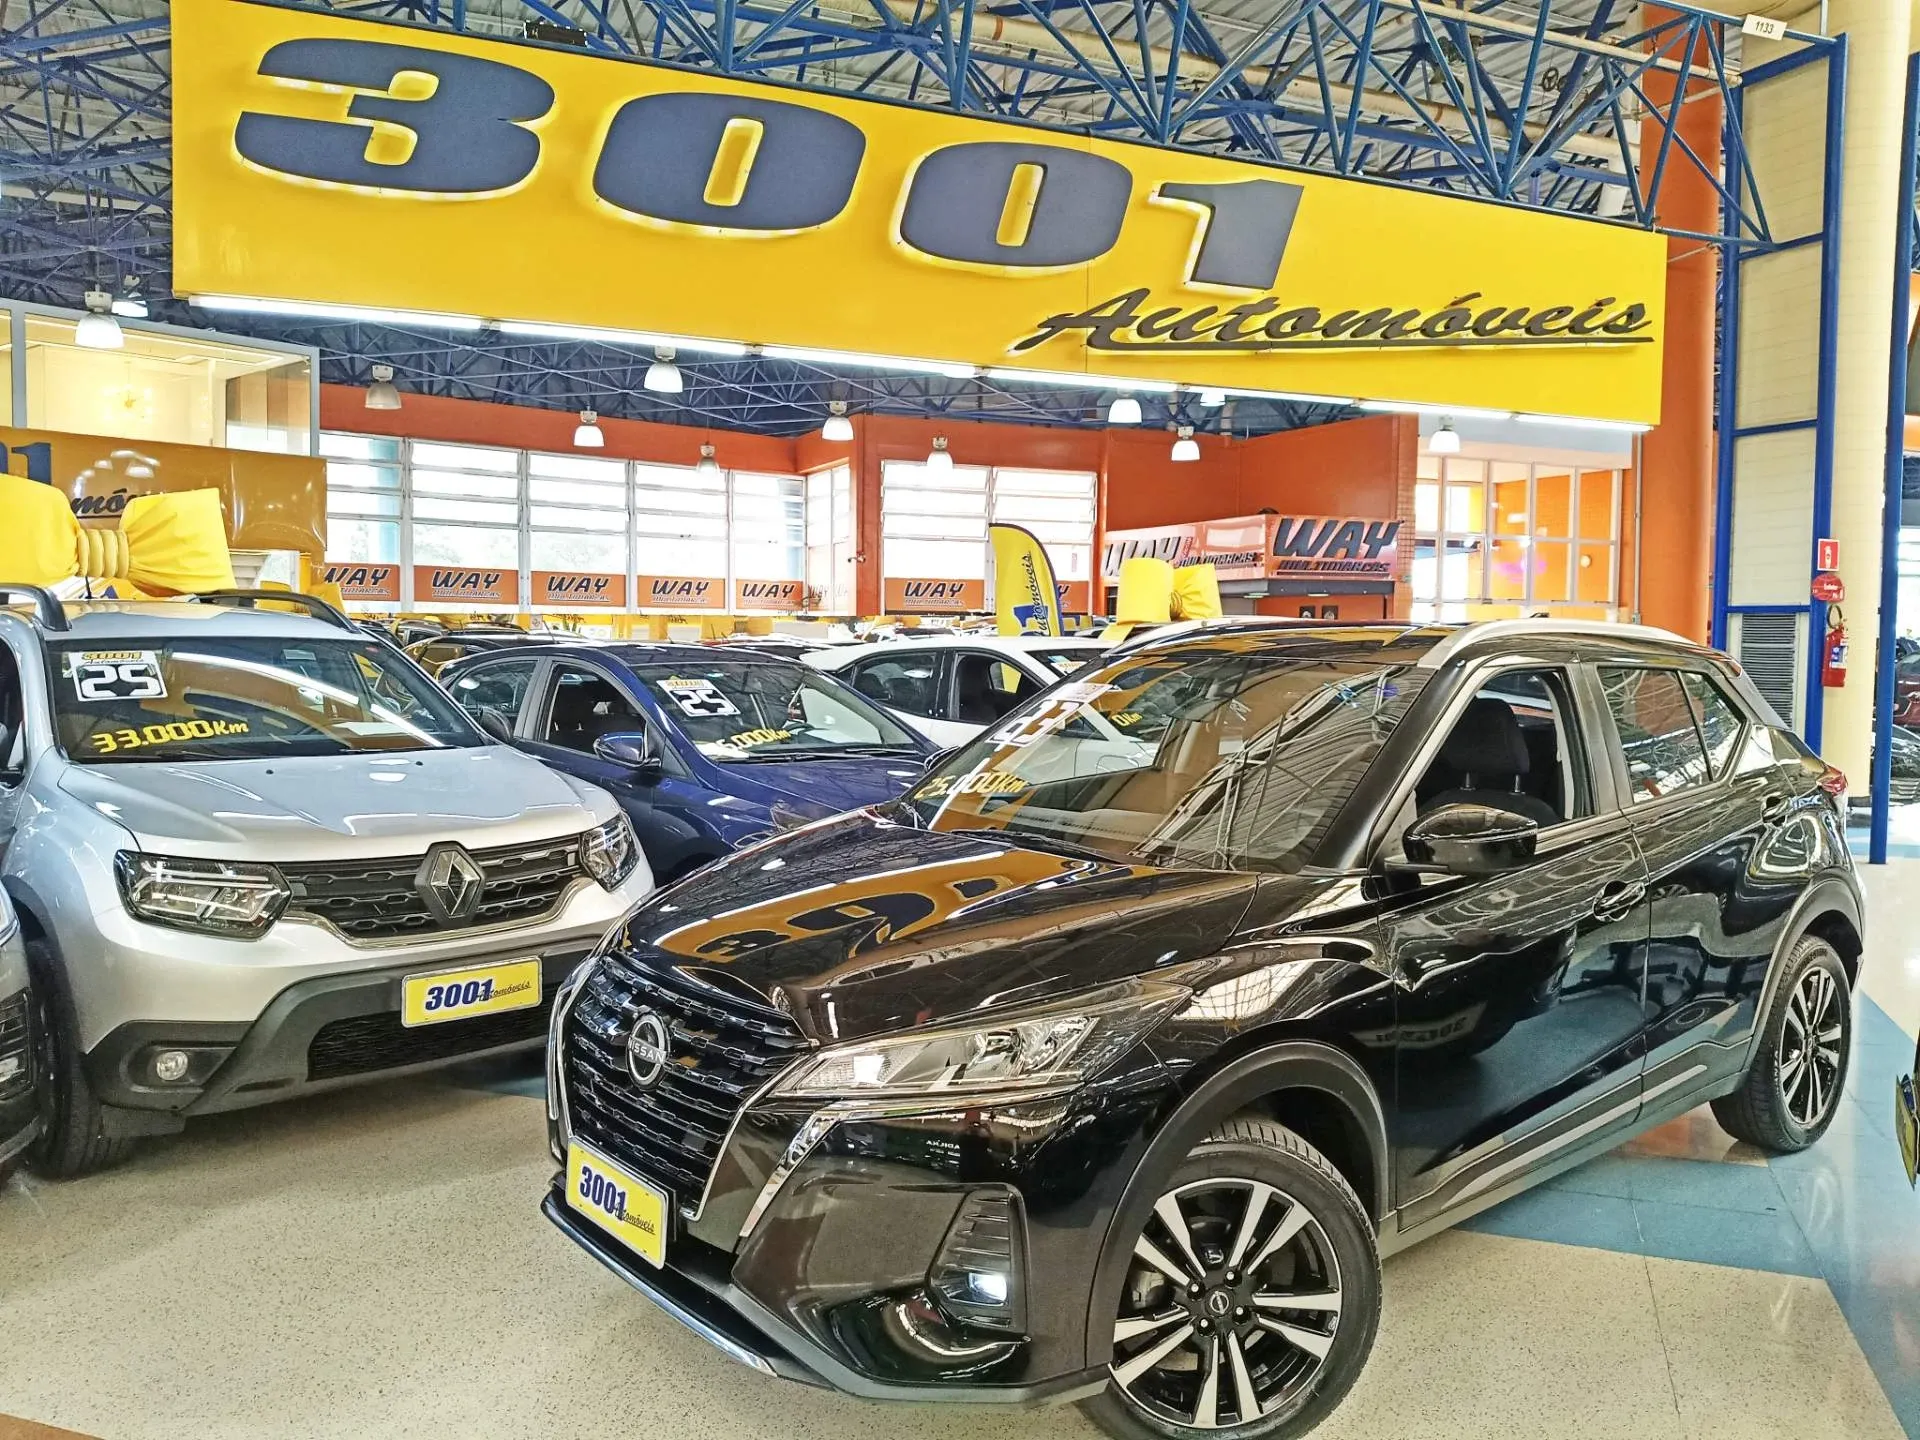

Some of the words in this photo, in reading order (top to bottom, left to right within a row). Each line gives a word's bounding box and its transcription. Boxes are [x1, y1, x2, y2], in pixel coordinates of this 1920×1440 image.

[1755, 21, 1774, 34] 1133
[235, 38, 1304, 291] 3001
[1010, 288, 1653, 353] Automóveis
[1273, 518, 1399, 558] WAY
[432, 570, 500, 589] WAY
[1278, 560, 1390, 572] MULTIMARCAS
[547, 576, 609, 593] WAY
[652, 580, 709, 596] WAY
[742, 583, 795, 598] WAY
[904, 581, 964, 598] WAY
[1020, 550, 1048, 632] utomóveis
[80, 664, 161, 698] 25
[670, 689, 737, 714] 25
[92, 720, 249, 753] 33.000Km
[425, 978, 493, 1011] 3001
[628, 1037, 666, 1065] NISSAN
[580, 1165, 626, 1221] 3001
